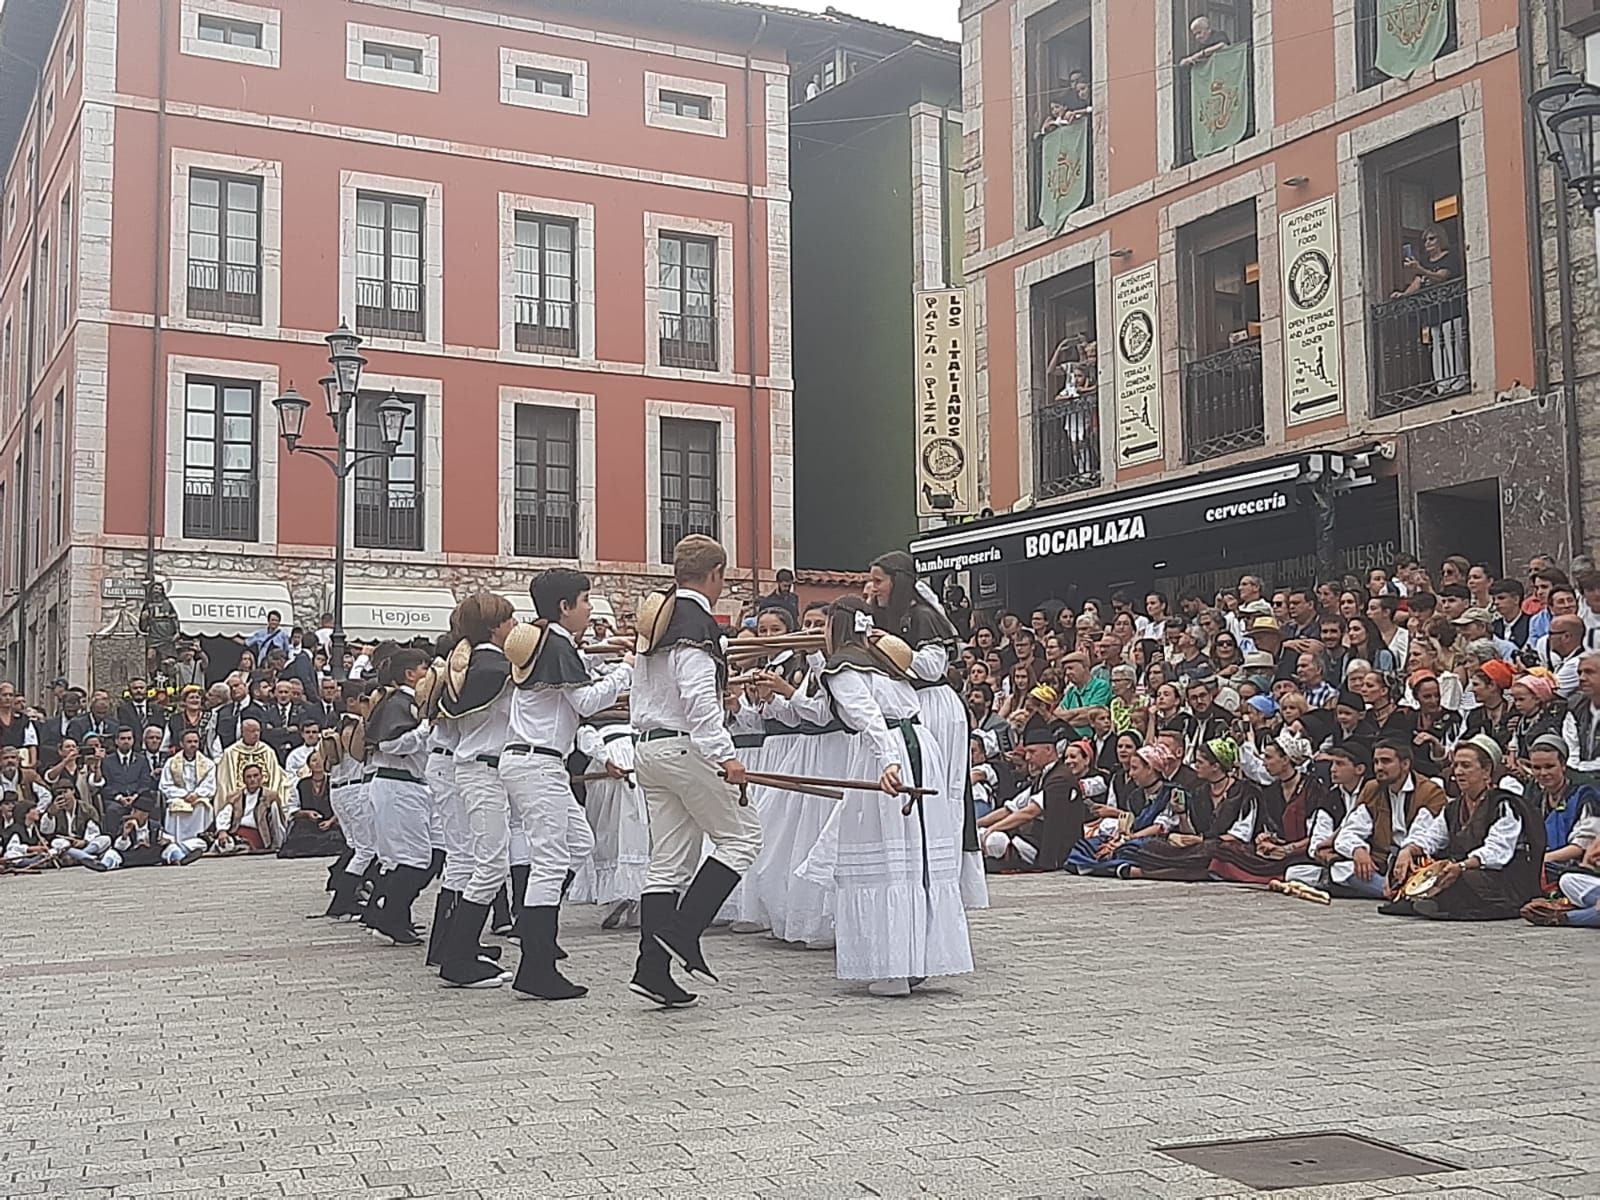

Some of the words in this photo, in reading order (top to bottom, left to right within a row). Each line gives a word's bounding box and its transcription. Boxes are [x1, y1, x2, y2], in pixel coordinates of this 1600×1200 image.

[1292, 220, 1322, 237] ITALIAN
[1297, 234, 1318, 247] FOOD
[924, 296, 938, 355] PASTA
[948, 295, 961, 327] LOS
[1288, 318, 1305, 330] OPEN
[1306, 307, 1334, 323] TERRACE
[947, 339, 961, 437] ITALIANOS
[923, 377, 937, 435] PIZZA
[1205, 492, 1287, 522] cervecería
[1025, 515, 1146, 559] BOCAPLAZA
[914, 546, 1001, 572] hamburguesería
